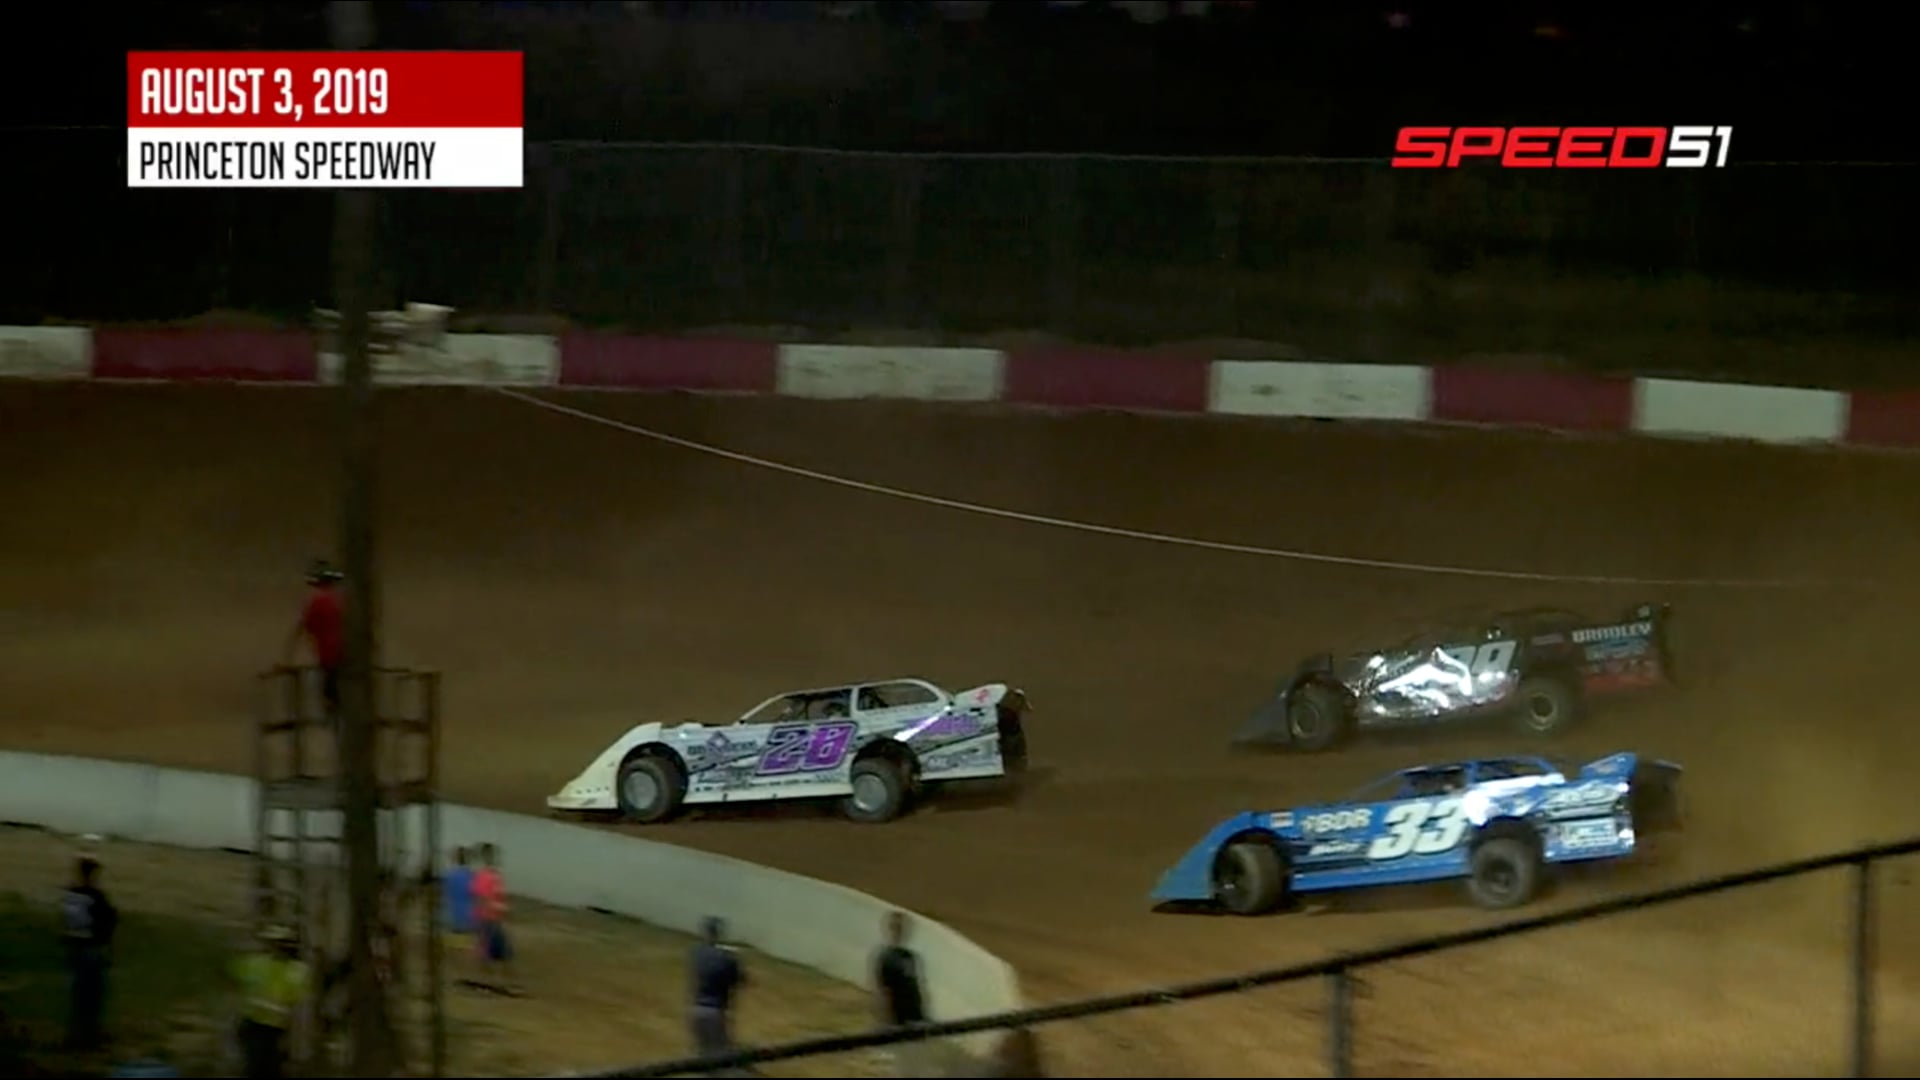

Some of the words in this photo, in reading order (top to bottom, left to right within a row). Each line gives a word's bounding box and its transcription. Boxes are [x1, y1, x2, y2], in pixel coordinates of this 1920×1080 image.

[1571, 621, 1652, 644] BRADLEY
[756, 721, 859, 777] 28
[1367, 799, 1471, 860] 33
